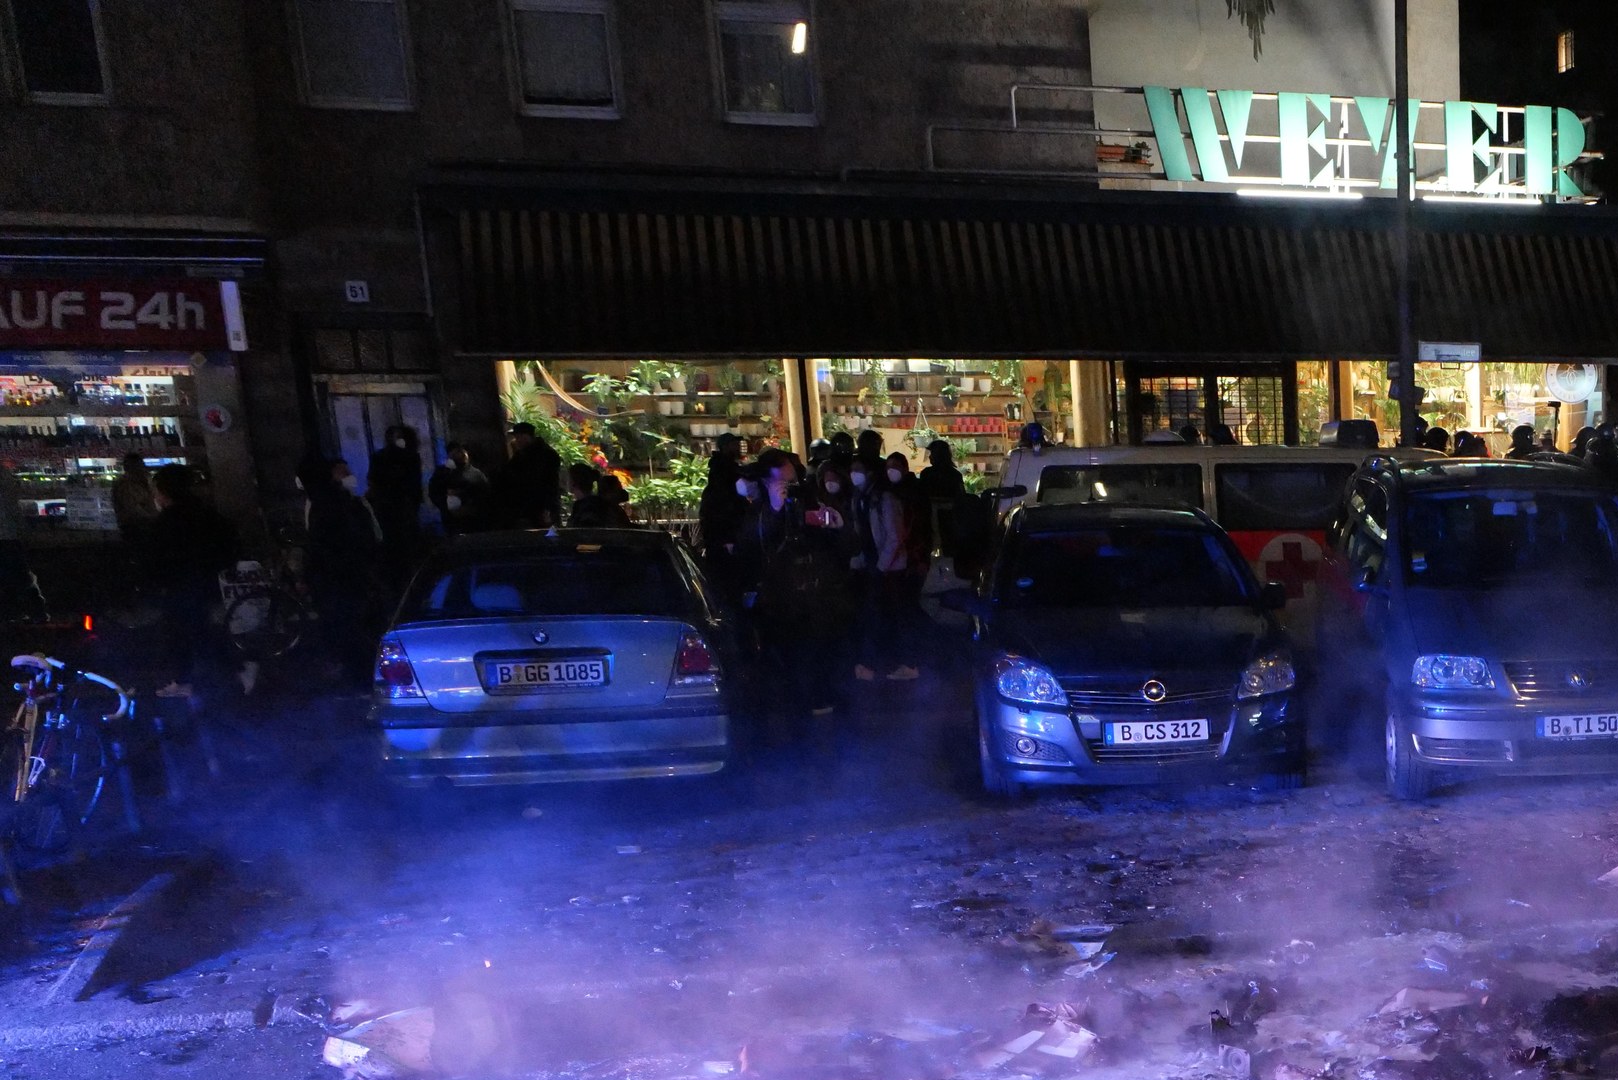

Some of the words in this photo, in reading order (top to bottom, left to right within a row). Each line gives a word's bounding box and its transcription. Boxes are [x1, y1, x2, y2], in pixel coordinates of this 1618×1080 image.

[0, 290, 86, 330] UF
[101, 291, 207, 331] 24h
[500, 666, 512, 683] B
[524, 664, 550, 682] GG
[554, 663, 600, 681] 1085
[1121, 725, 1132, 741] B
[1144, 723, 1166, 740] CS
[1170, 722, 1201, 739] 312
[1551, 718, 1561, 734] B
[1573, 717, 1593, 733] TI
